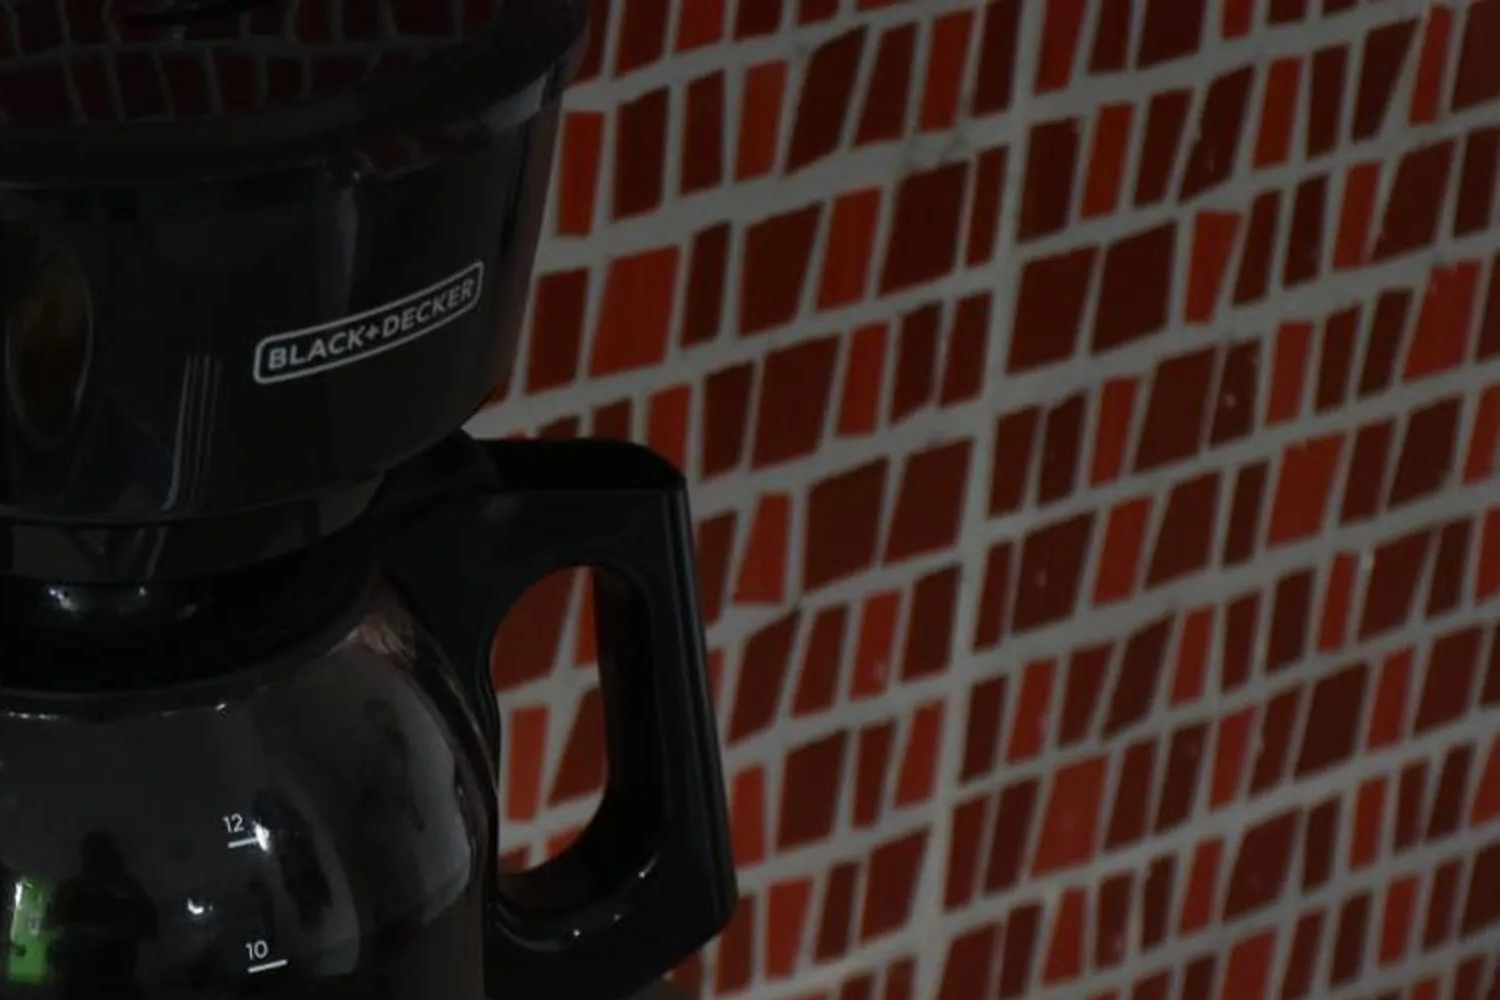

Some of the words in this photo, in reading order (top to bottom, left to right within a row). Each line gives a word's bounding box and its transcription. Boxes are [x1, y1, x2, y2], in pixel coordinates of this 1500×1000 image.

[266, 277, 475, 372] BLACK+DECKER
[222, 812, 245, 834] 12
[245, 940, 269, 961] 10
